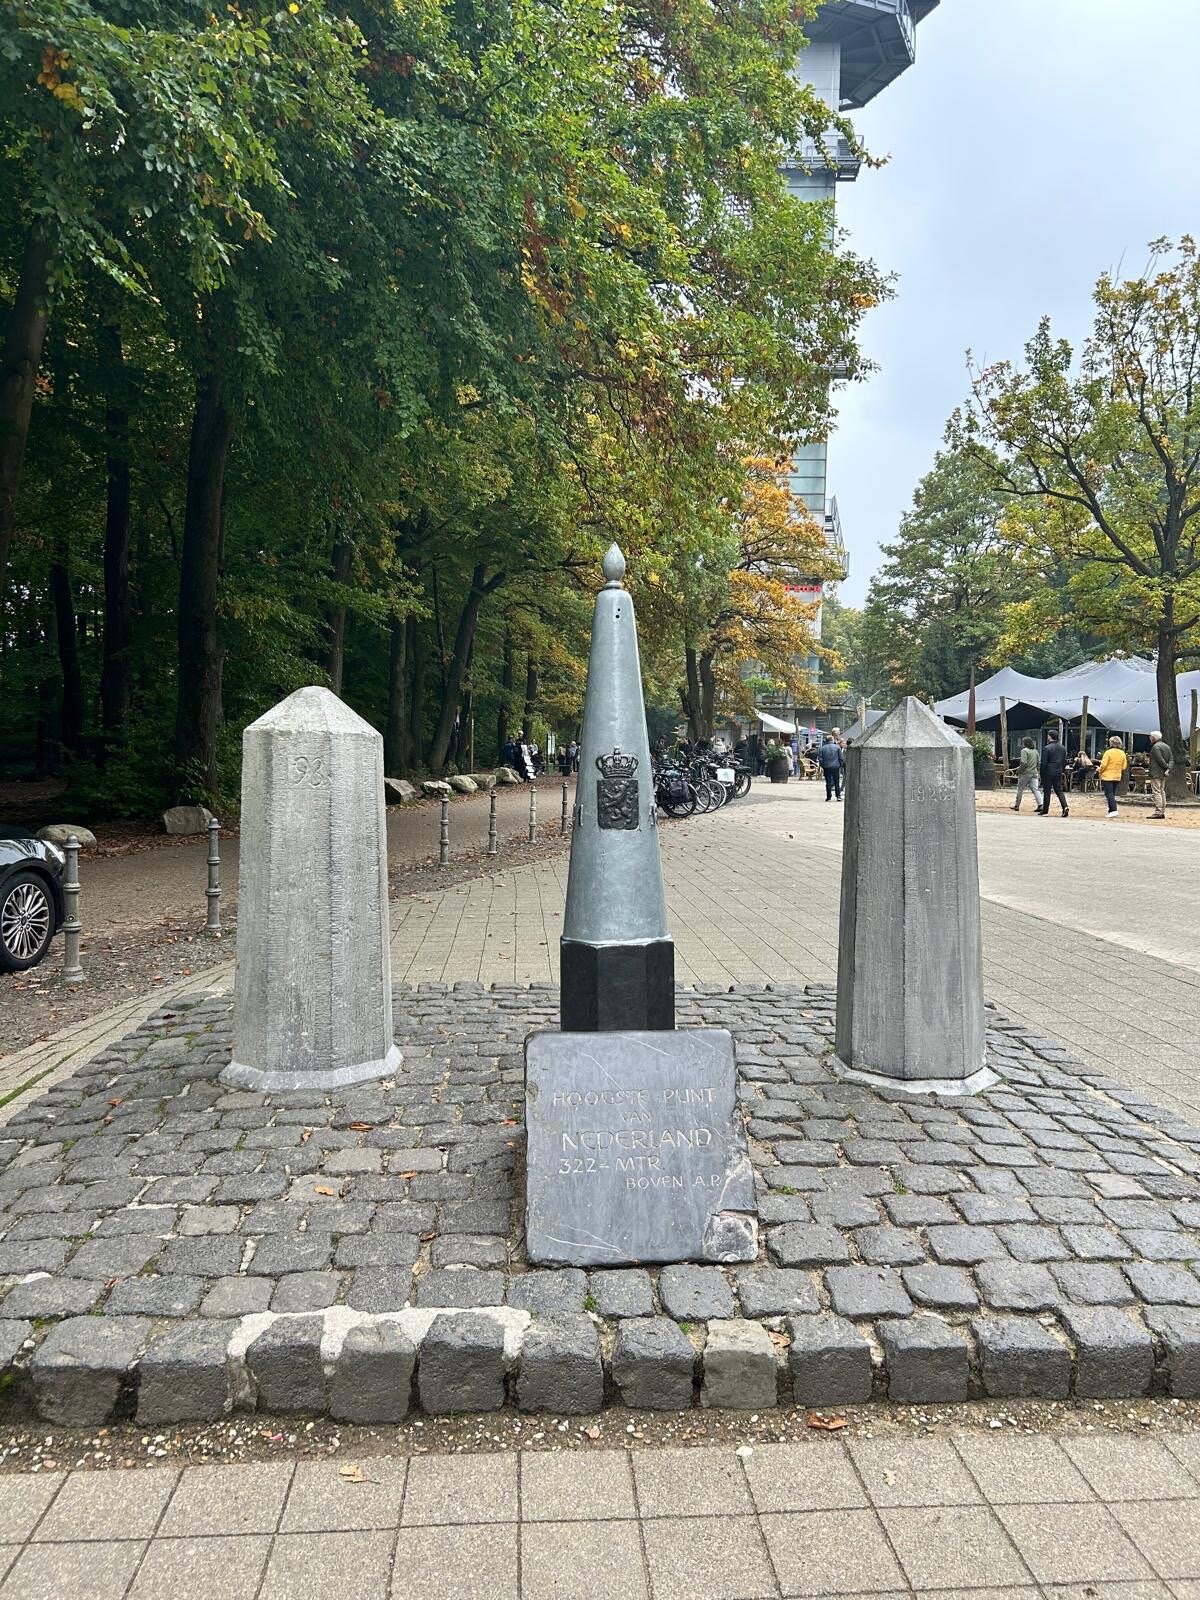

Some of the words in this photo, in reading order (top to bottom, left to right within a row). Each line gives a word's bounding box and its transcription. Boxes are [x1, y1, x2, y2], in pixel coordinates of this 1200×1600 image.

[553, 1089, 648, 1107] HOOGSTE
[663, 1087, 716, 1103] PUNT
[623, 1111, 652, 1123] VAN
[562, 1128, 712, 1151] NEDERLAND
[626, 1176, 683, 1190] BOVEN
